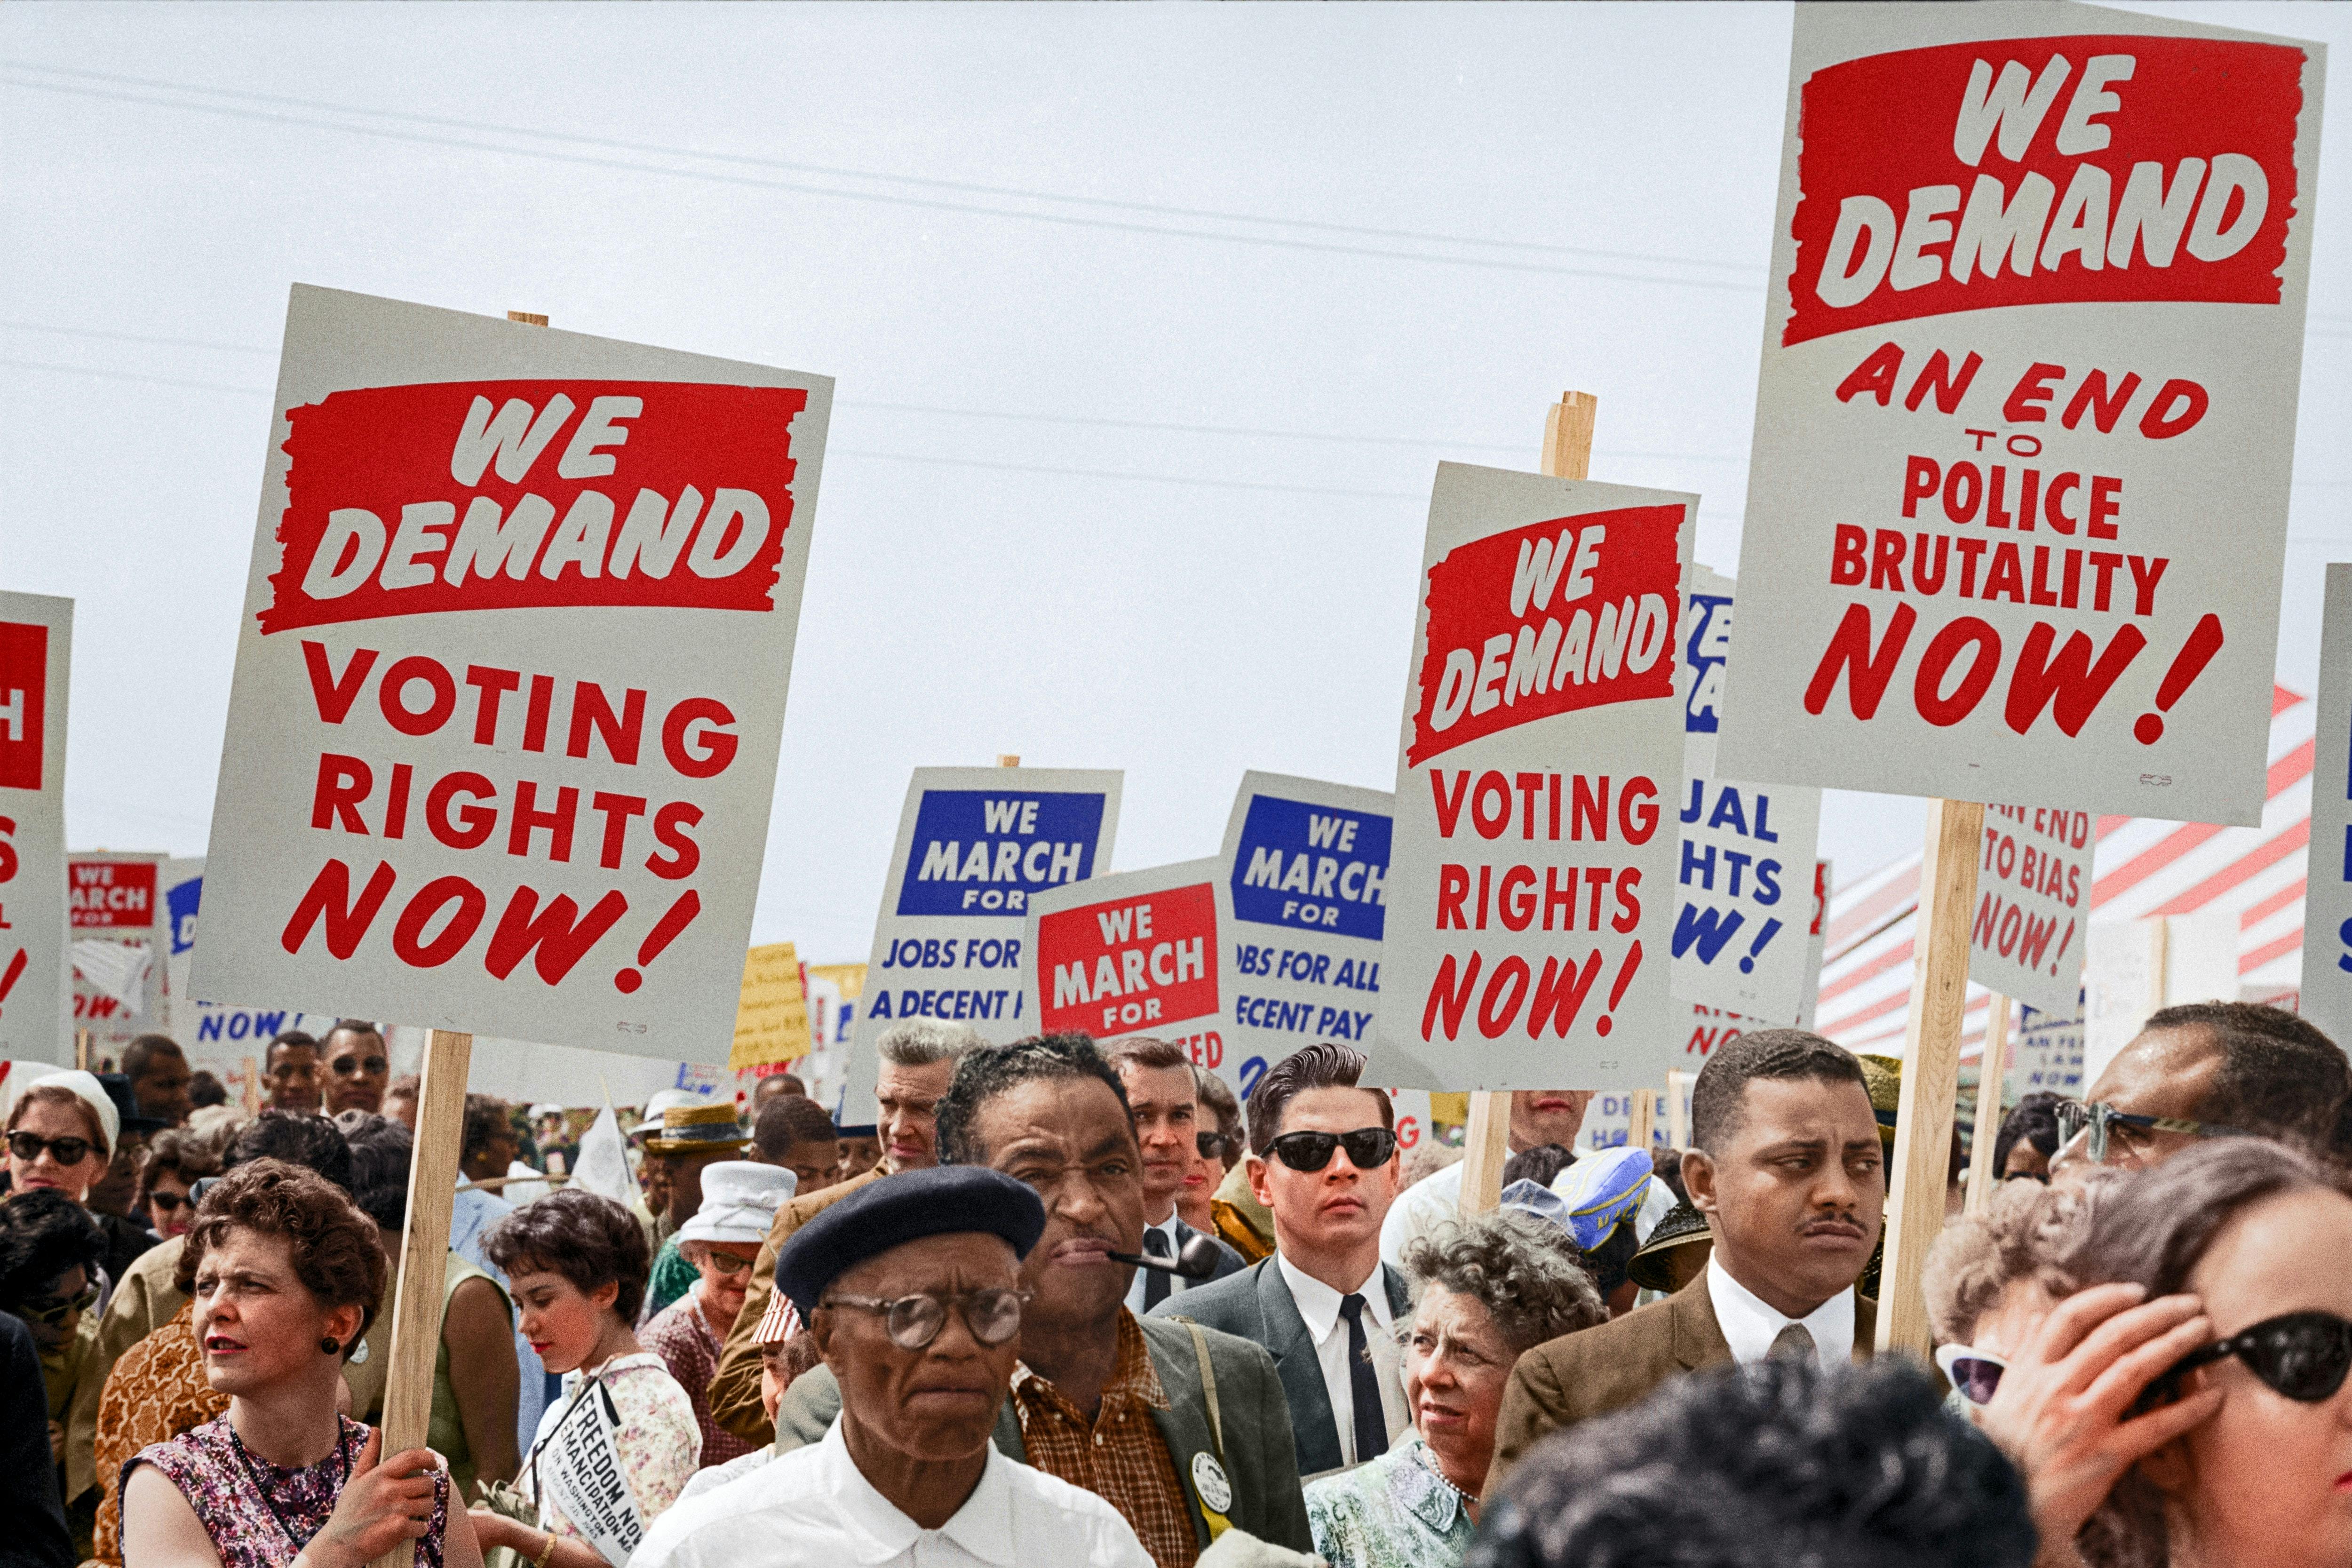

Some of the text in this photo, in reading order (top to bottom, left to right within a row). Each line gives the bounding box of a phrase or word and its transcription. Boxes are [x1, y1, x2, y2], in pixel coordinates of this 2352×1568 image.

[1955, 55, 2136, 167] WE
[1816, 152, 2269, 308] DEMAND
[1836, 341, 2209, 439] AN END
[452, 394, 642, 486] WE
[1965, 429, 2042, 457] TO
[1902, 454, 2122, 541] POLICE
[302, 484, 771, 600] DEMAND
[1510, 524, 1605, 618] WE
[1830, 523, 2169, 616] BRUTALITY
[1431, 594, 1669, 731] DEMAND
[1804, 602, 2224, 745] NOW!
[301, 640, 739, 779] VOTING
[311, 752, 704, 880] RIGHTS
[985, 800, 1039, 834] WE
[1309, 815, 1358, 852] WE
[1430, 769, 1660, 846] VOTING
[918, 841, 1082, 883] MARCH
[962, 890, 1025, 909] FOR
[1436, 864, 1642, 934] RIGHTS
[1986, 828, 2082, 907] TO BIAS
[281, 858, 701, 994] NOW!
[882, 939, 1020, 968] JOBS FOR
[1097, 901, 1151, 945] WE
[1281, 902, 1338, 927] FOR
[1973, 891, 2075, 976] NOW!
[869, 991, 891, 1019] A
[898, 990, 1009, 1019] DECENT
[1055, 938, 1203, 1008] MARCH
[1277, 950, 1330, 984] FOR
[1333, 959, 1379, 992] ALL
[1421, 939, 1643, 1042] NOW!
[1104, 999, 1160, 1027] FOR
[1317, 1007, 1372, 1041] PAY
[561, 1420, 621, 1536] EMANCIPATION
[576, 1393, 624, 1504] FREEDOM
[561, 1467, 606, 1536] WASHINGTON
